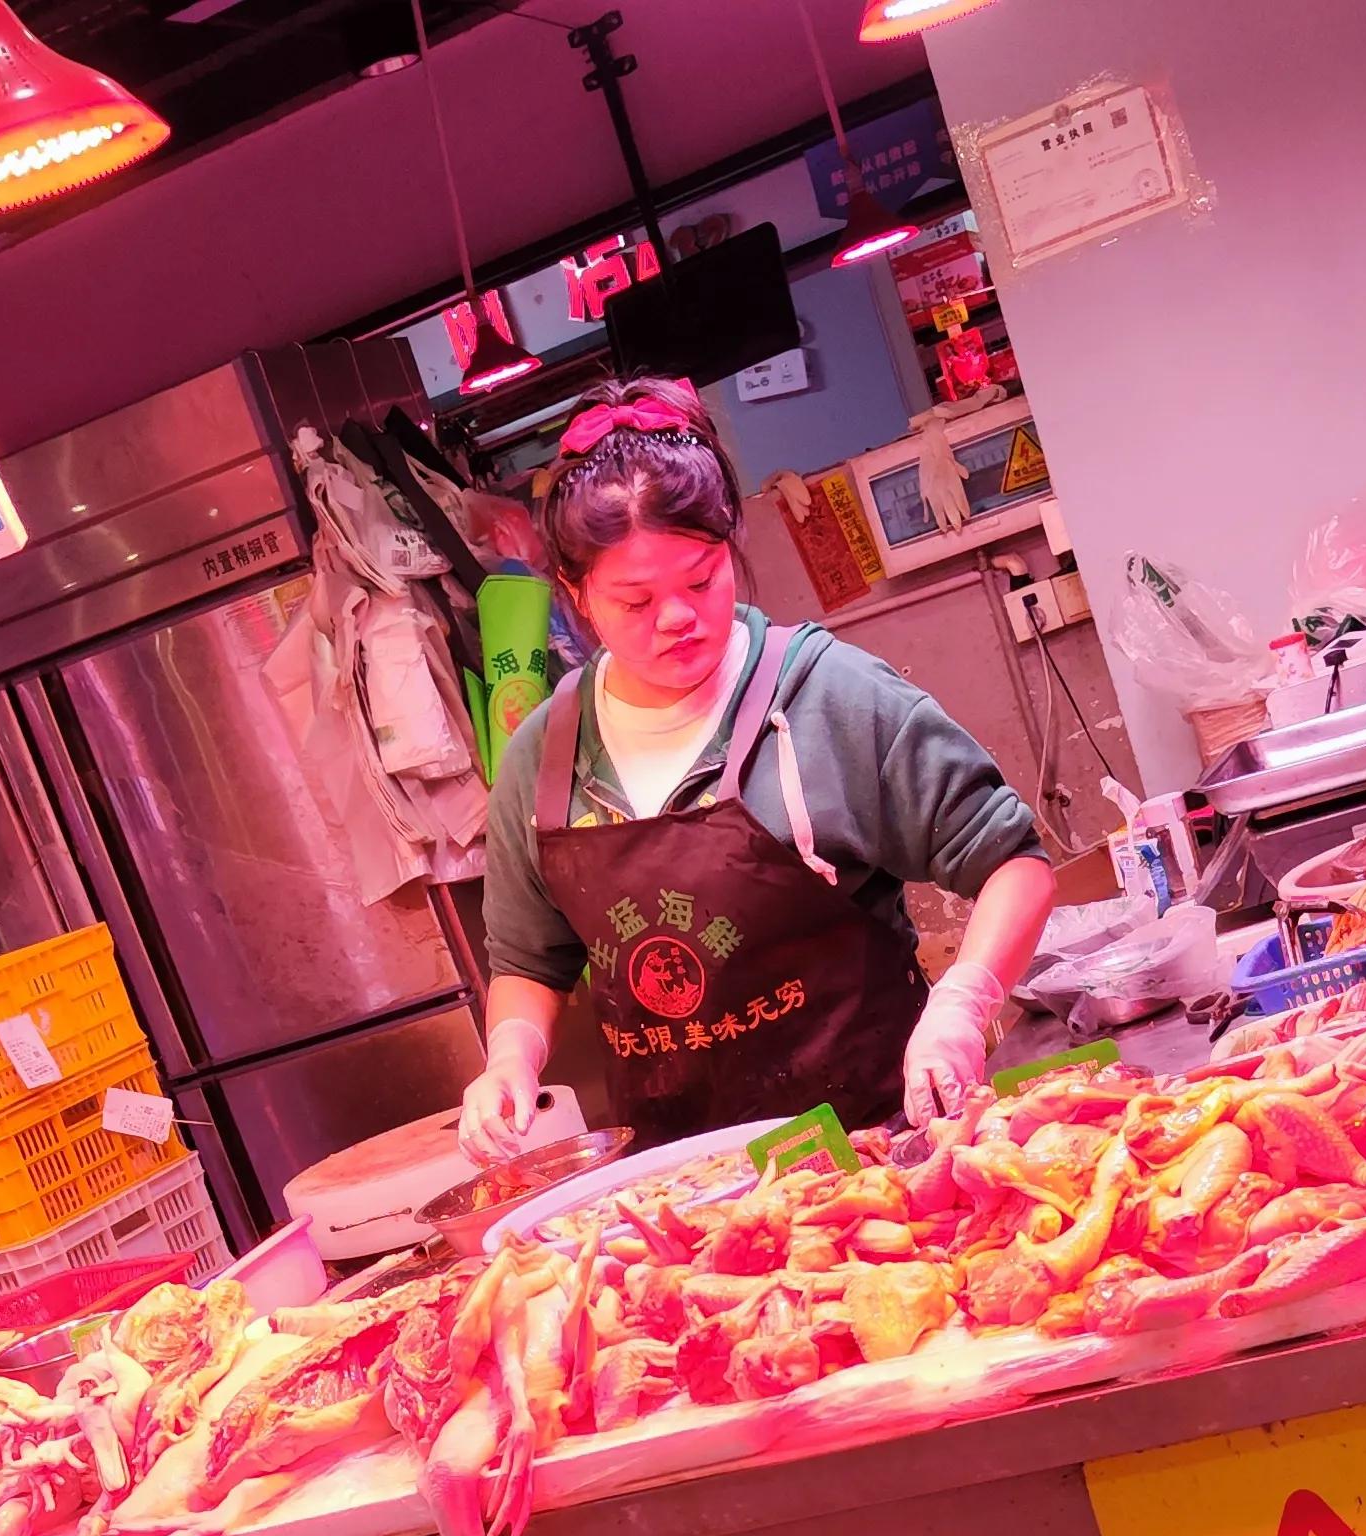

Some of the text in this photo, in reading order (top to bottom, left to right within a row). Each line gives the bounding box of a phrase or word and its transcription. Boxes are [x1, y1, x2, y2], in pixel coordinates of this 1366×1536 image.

[1041, 122, 1093, 151] 营业执照
[202, 531, 280, 580] 内置精铜管
[588, 888, 745, 979] 生猛海鲜
[684, 979, 806, 1051] 美味无穷
